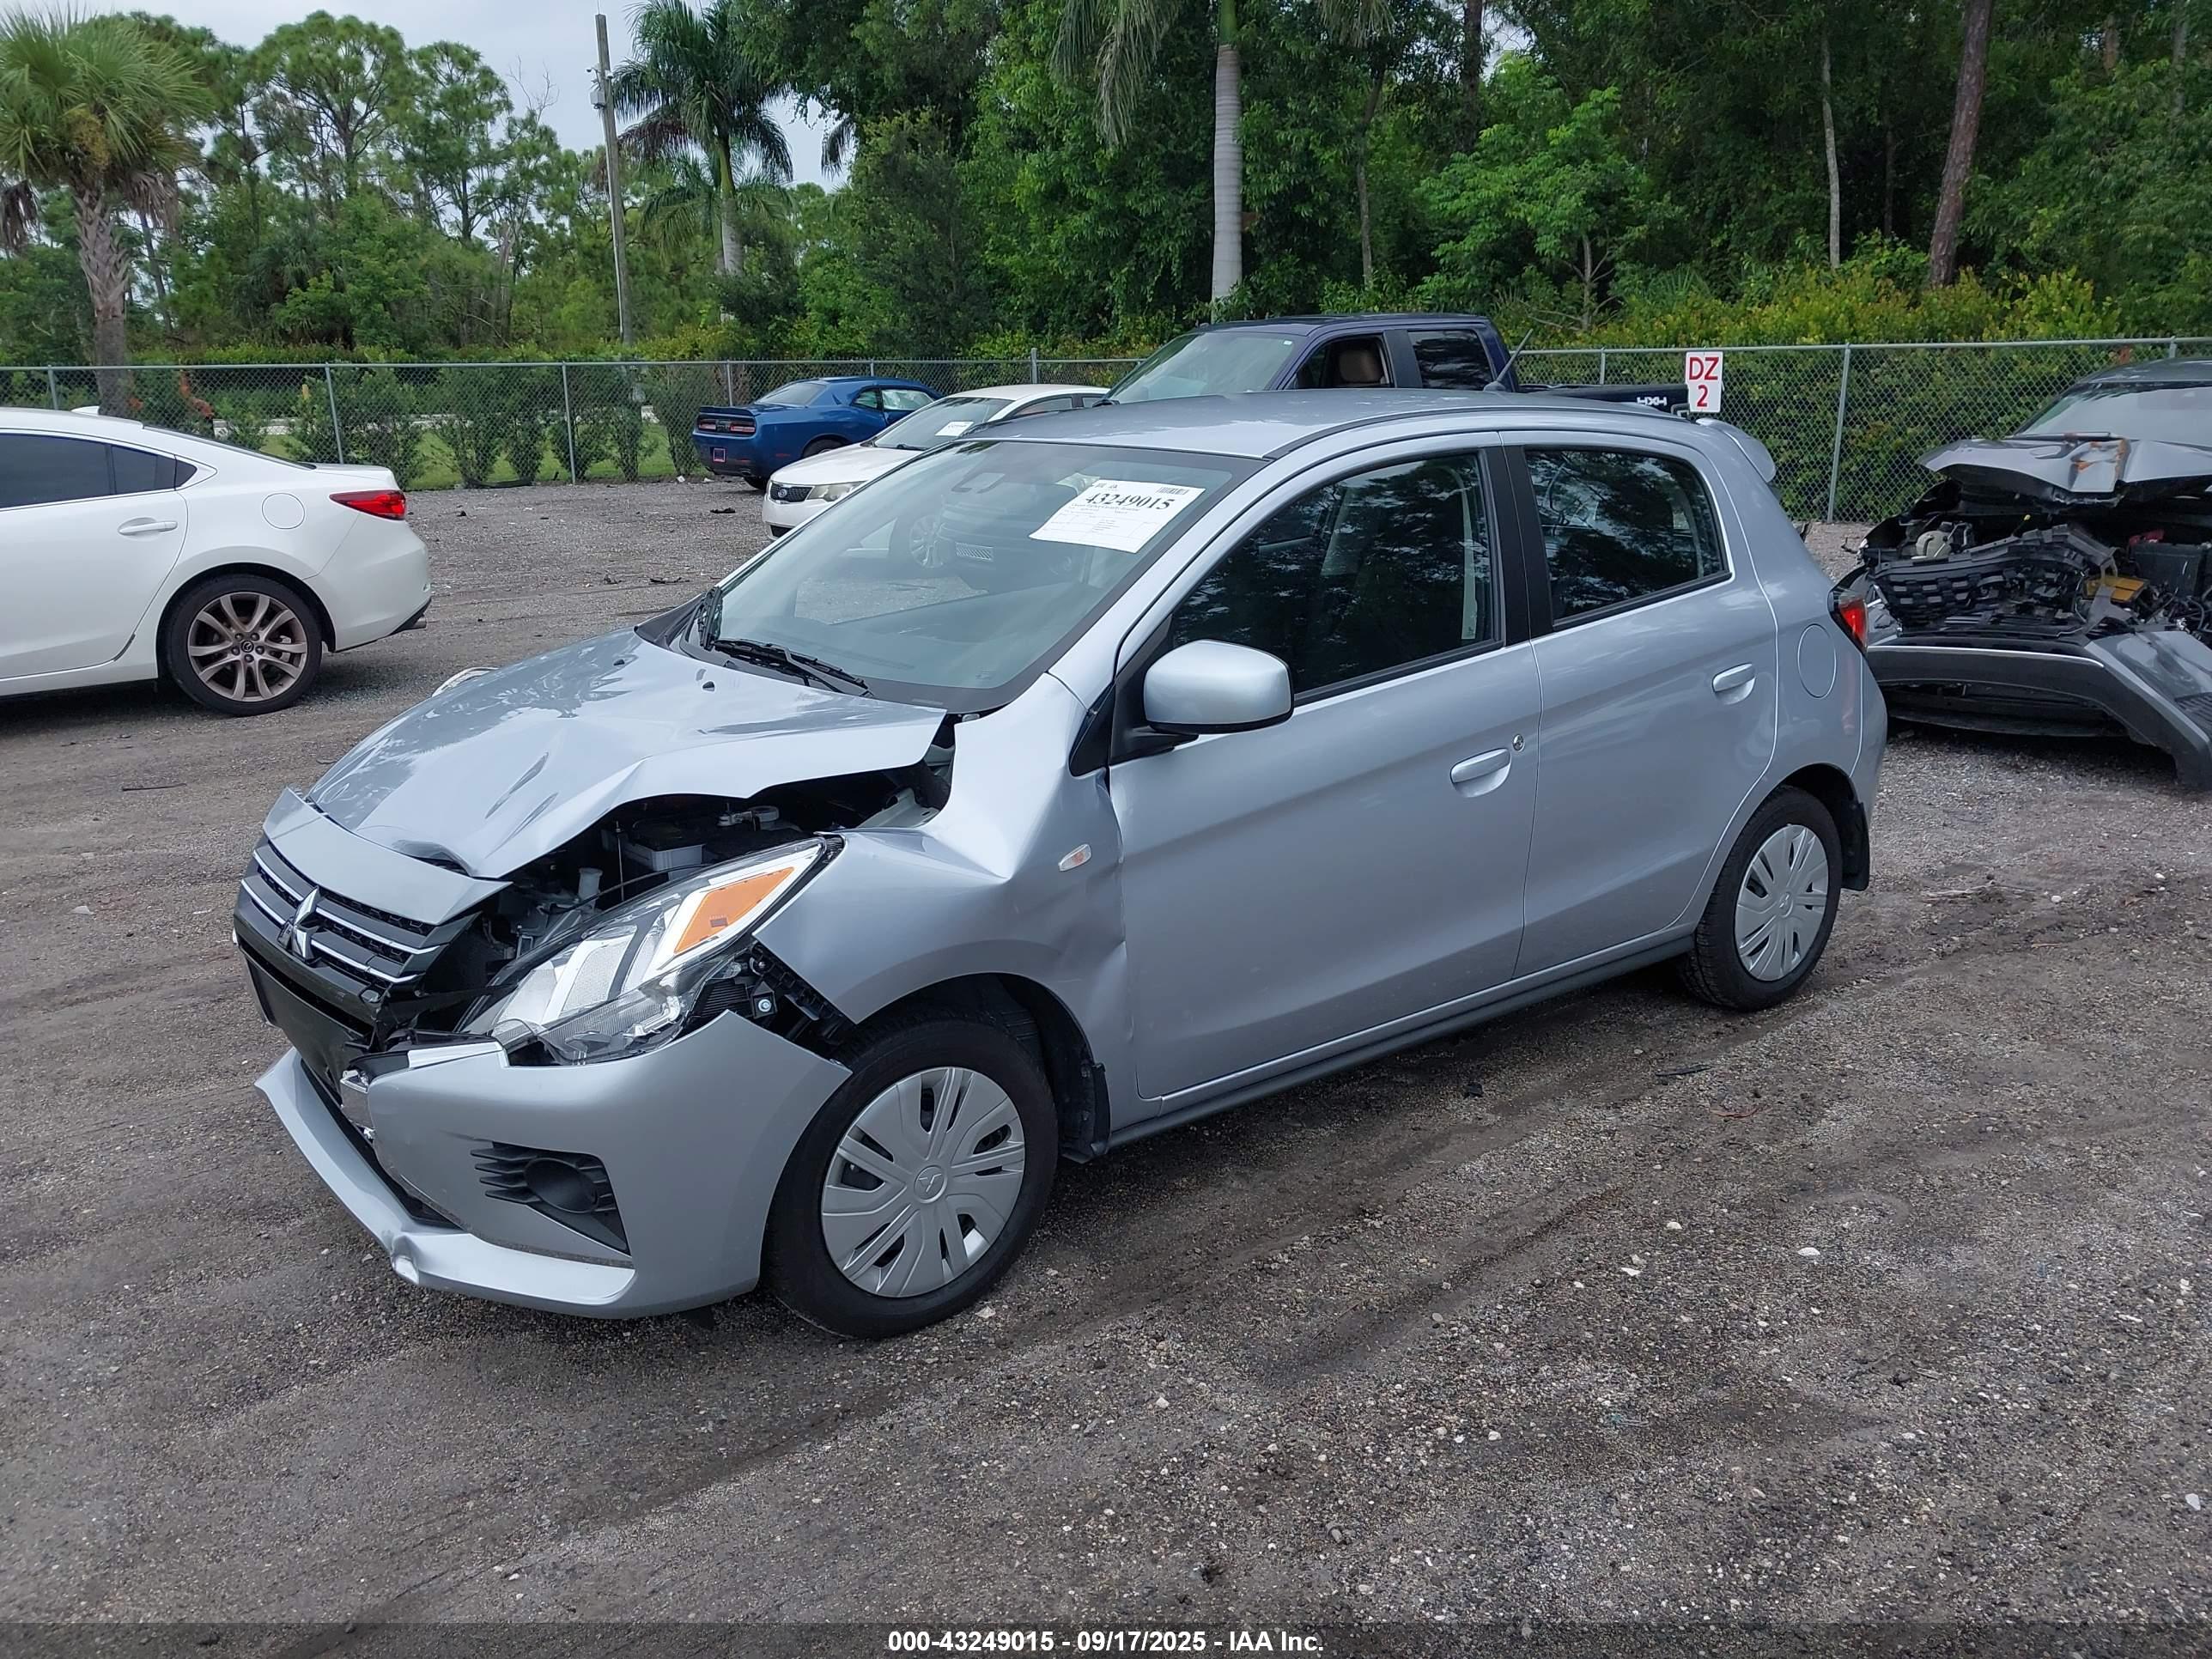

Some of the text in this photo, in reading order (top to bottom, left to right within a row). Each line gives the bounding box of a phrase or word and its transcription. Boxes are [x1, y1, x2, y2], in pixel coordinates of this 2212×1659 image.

[1689, 357, 1719, 380] DZ
[1697, 386, 1708, 407] 2
[1085, 492, 1176, 510] 43249015
